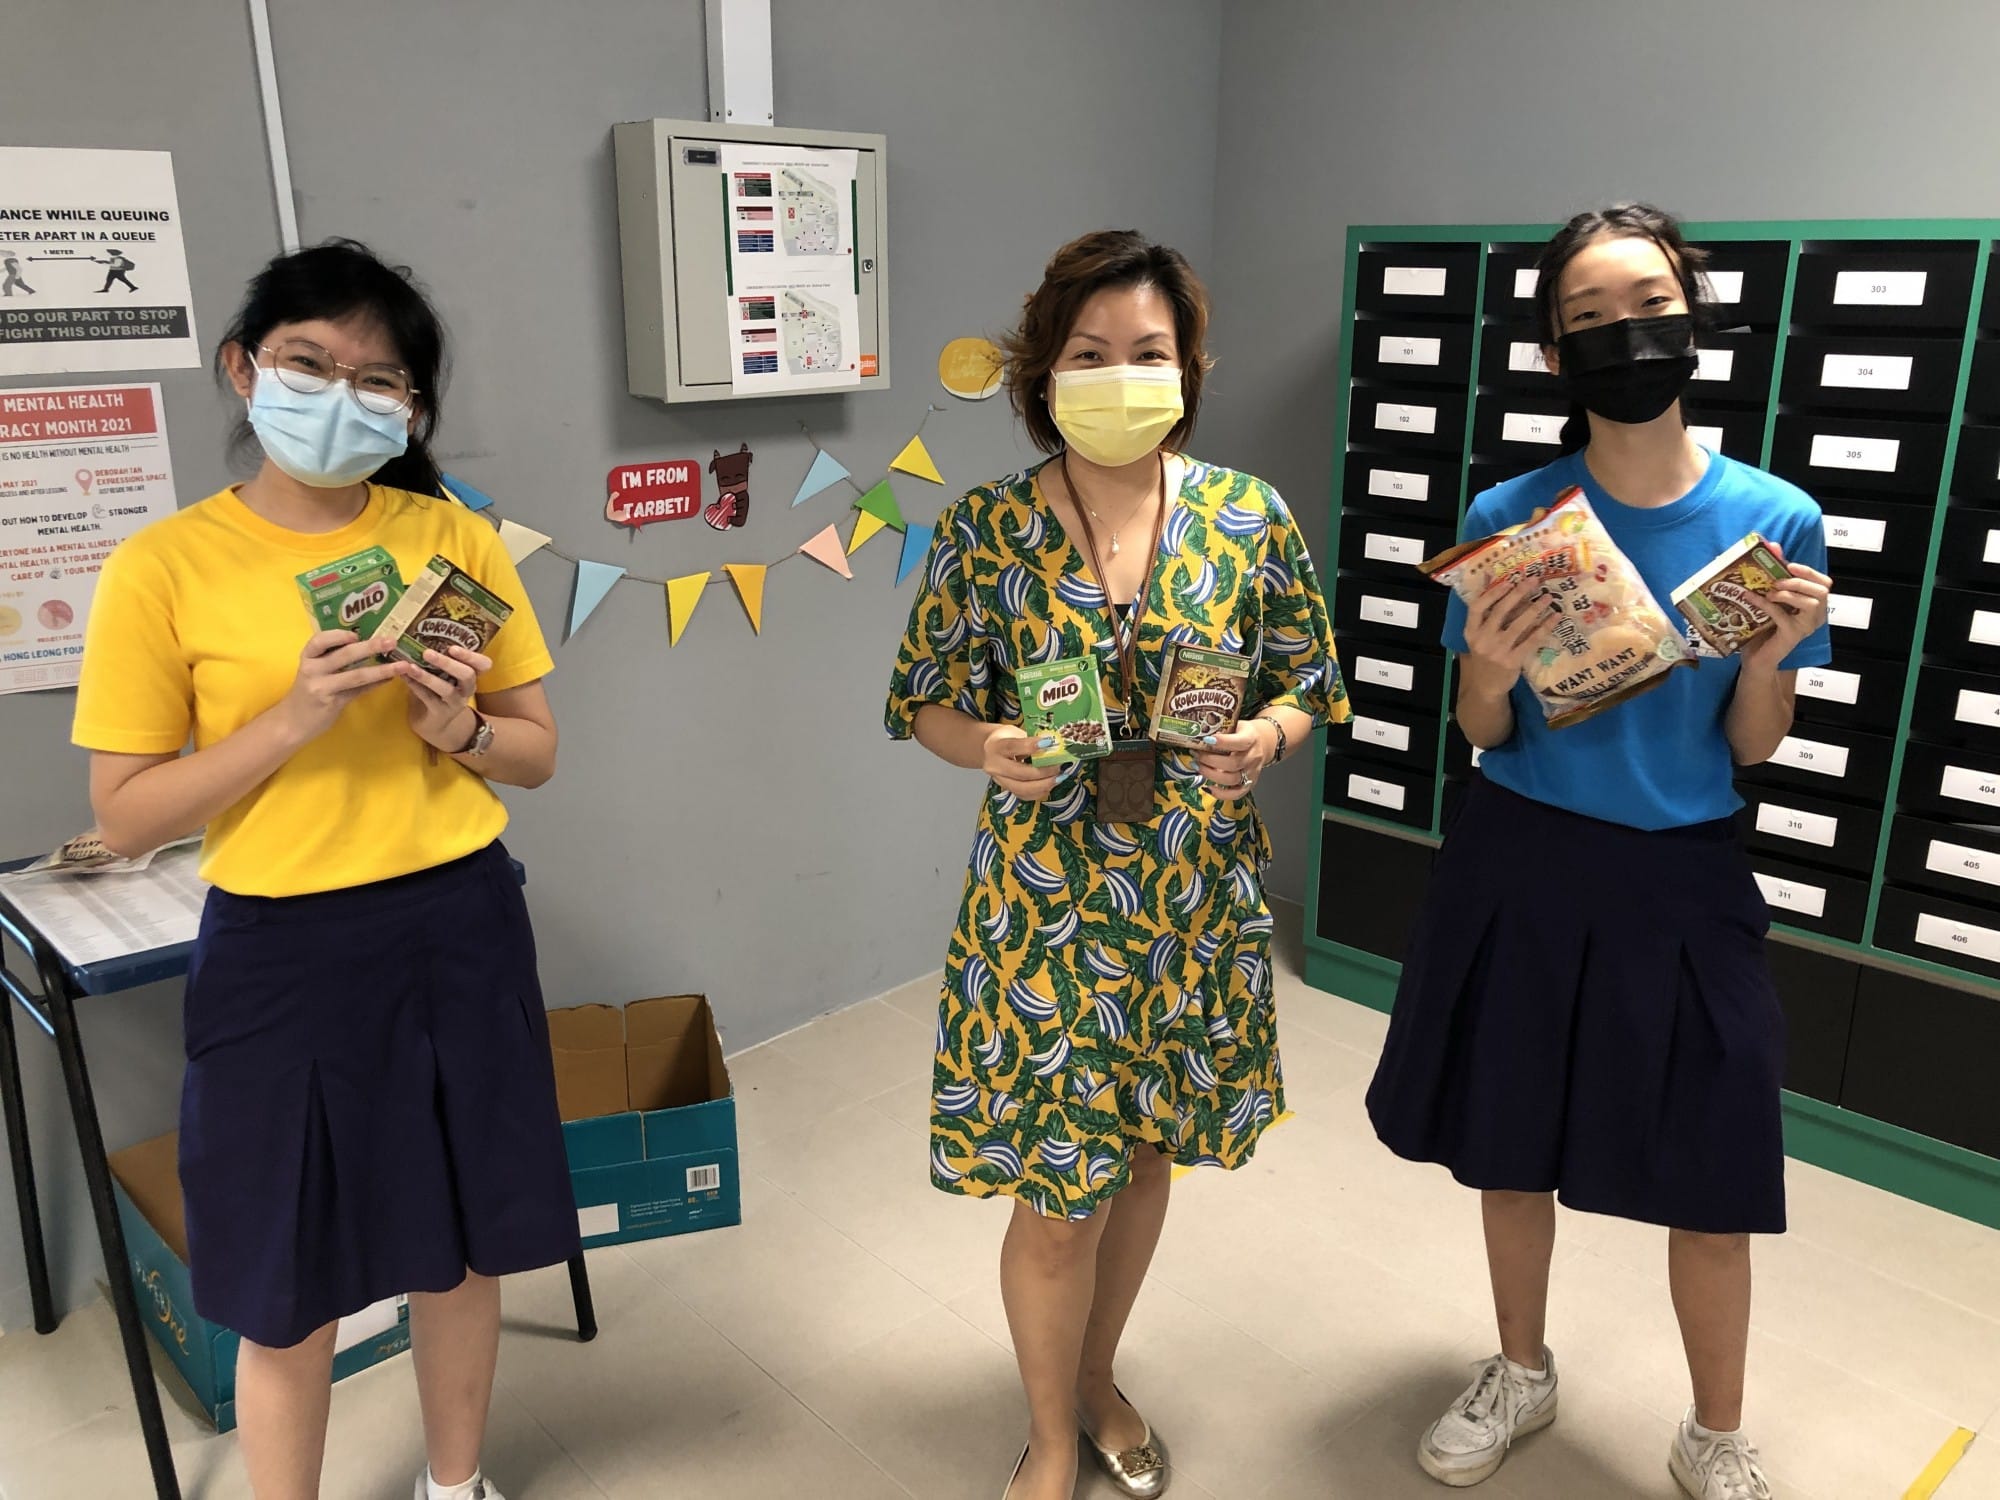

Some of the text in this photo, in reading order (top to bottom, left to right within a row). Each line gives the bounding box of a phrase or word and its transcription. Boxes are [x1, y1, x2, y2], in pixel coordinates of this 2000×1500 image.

[46, 209, 97, 221] WHILE
[100, 210, 170, 222] QUEUING
[34, 231, 77, 241] APART
[81, 231, 96, 241] IN
[99, 231, 109, 241] A
[111, 231, 156, 241] QUEUE
[1871, 285, 1887, 294] 303
[6, 312, 29, 324] DO
[33, 311, 69, 323] OUR
[71, 310, 111, 322] PART
[113, 310, 136, 321] TO
[139, 309, 178, 320] STOP
[47, 326, 86, 338] THIS
[88, 324, 172, 337] OUTBREAK
[1402, 348, 1414, 356] 101
[1857, 368, 1873, 376] 304
[3, 392, 124, 413] MENTAL HEALTH
[1399, 415, 1410, 423] 102
[0, 416, 132, 439] RACY MONTH 2021
[1530, 426, 1542, 434] 111
[22, 449, 49, 460] HEALTH
[49, 447, 78, 458] WITHOUT
[78, 446, 105, 456] MENTAL
[105, 444, 130, 454] HEALTH
[1845, 450, 1862, 459] 305
[130, 466, 143, 475] TAN
[96, 473, 168, 486] EXPRESSIONS SPACE
[621, 466, 688, 489] I'M FROM
[624, 496, 690, 519] TARBET!
[2, 505, 148, 526] OUT HOW TO DEVELOP STRONGER
[37, 526, 70, 537] MENTAL
[1832, 528, 1849, 537] 306
[31, 546, 48, 554] HAS
[49, 545, 56, 553] A
[56, 542, 87, 552] MENTAL
[10, 571, 33, 581] CARE
[34, 570, 44, 579] OF
[64, 566, 85, 575] YOUR
[344, 590, 385, 619] MILO
[3, 650, 30, 661] HONG
[31, 648, 62, 660] LEONG
[1556, 647, 1637, 693] WANT WANT
[1808, 679, 1824, 688] 308
[1043, 682, 1079, 704] MILO
[1798, 751, 1814, 760] 309
[1978, 785, 1996, 795] 404
[1787, 820, 1803, 830] 310
[1963, 860, 1980, 870] 405
[1778, 890, 1791, 900] 311
[1951, 934, 1968, 944] 406
